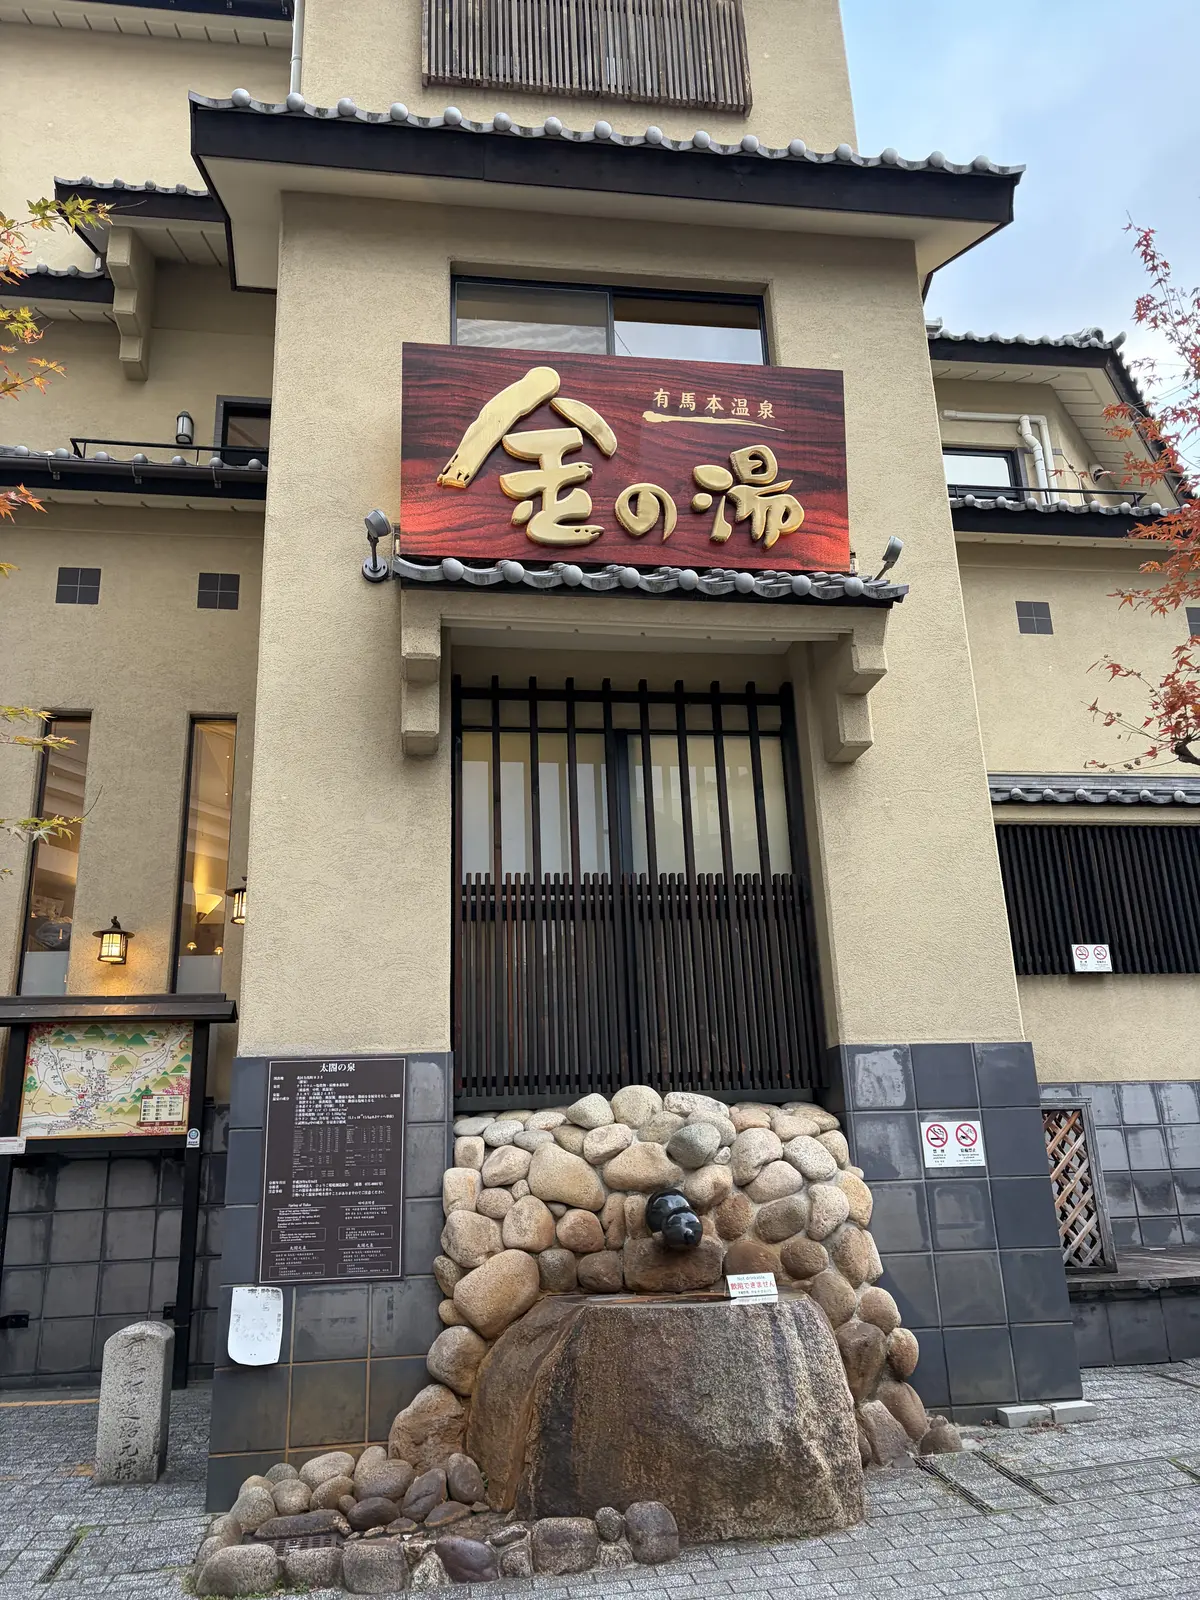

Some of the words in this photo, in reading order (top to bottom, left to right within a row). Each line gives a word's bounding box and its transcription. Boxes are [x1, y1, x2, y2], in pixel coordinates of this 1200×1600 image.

[653, 387, 776, 420] 有馬本温泉
[436, 366, 806, 550] 金の湯
[320, 1063, 356, 1073] 太閤の泉
